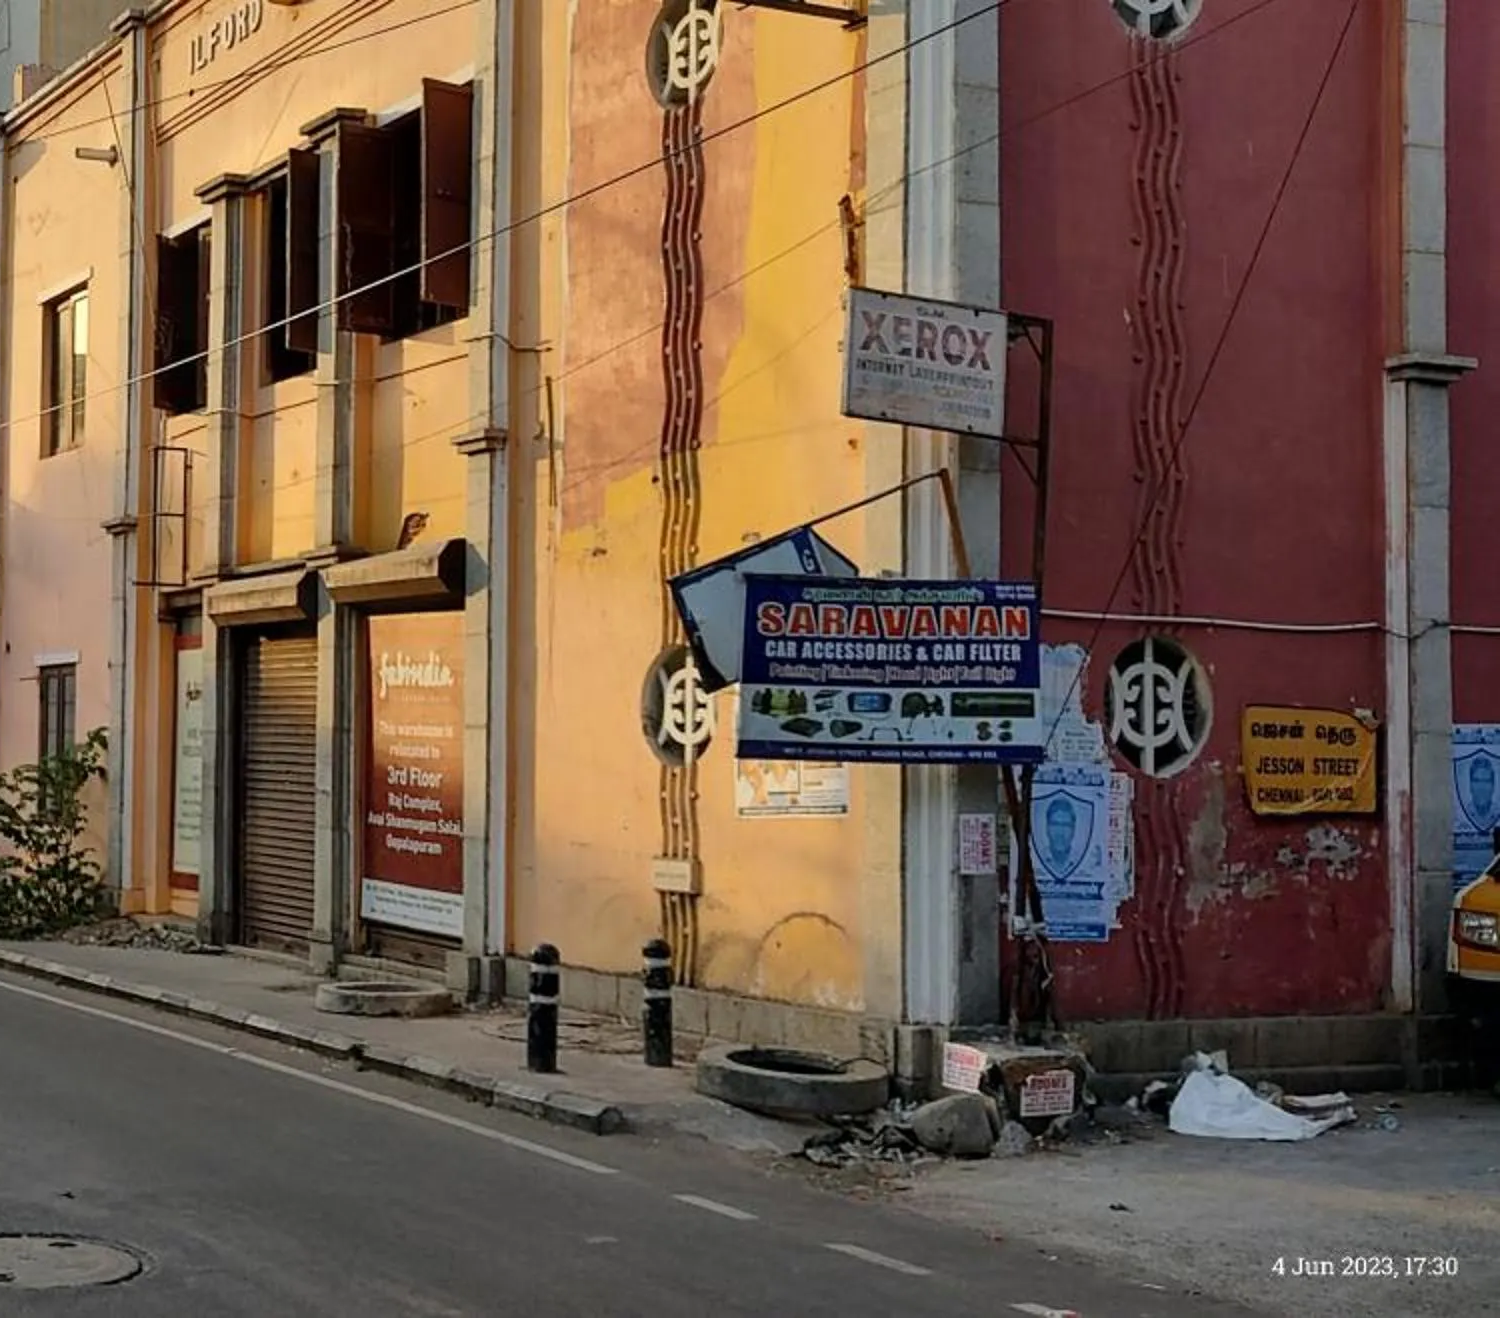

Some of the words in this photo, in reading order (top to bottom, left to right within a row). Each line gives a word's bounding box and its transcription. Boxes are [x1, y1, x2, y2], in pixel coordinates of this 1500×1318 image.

[190, 0, 263, 76] ILFORD
[860, 310, 993, 371] XEROX
[856, 357, 905, 377] INTERNET
[757, 601, 1031, 640] SARAVANAN
[765, 640, 797, 658] CAR
[802, 641, 913, 661] ACCESSORIES
[916, 646, 929, 661] &
[933, 643, 965, 661] CAR
[970, 643, 1021, 662] FILTER
[379, 651, 454, 699] fabindia
[387, 765, 407, 786] 3rd
[409, 766, 442, 789] Floor
[1256, 757, 1304, 775] JESSON
[1313, 757, 1359, 776] STREET
